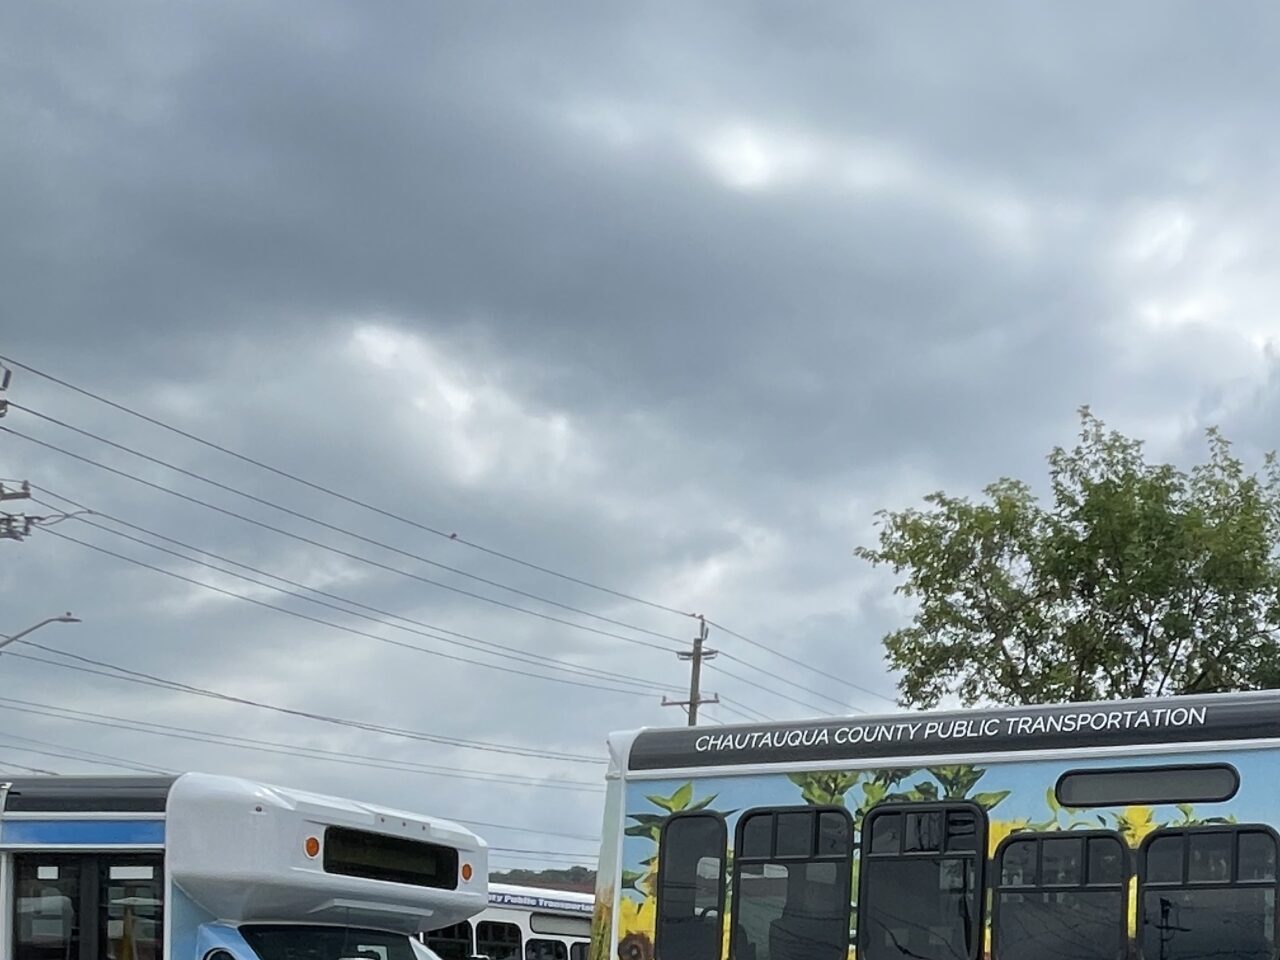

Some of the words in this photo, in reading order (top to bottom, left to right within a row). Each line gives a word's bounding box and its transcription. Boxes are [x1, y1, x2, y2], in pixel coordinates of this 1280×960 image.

[695, 728, 829, 751] CHAUTAUQUA
[834, 723, 922, 744] COUNTY
[924, 718, 1000, 739] PUBLIC
[1006, 707, 1207, 735] TRANSPORTATION
[504, 895, 537, 906] Public
